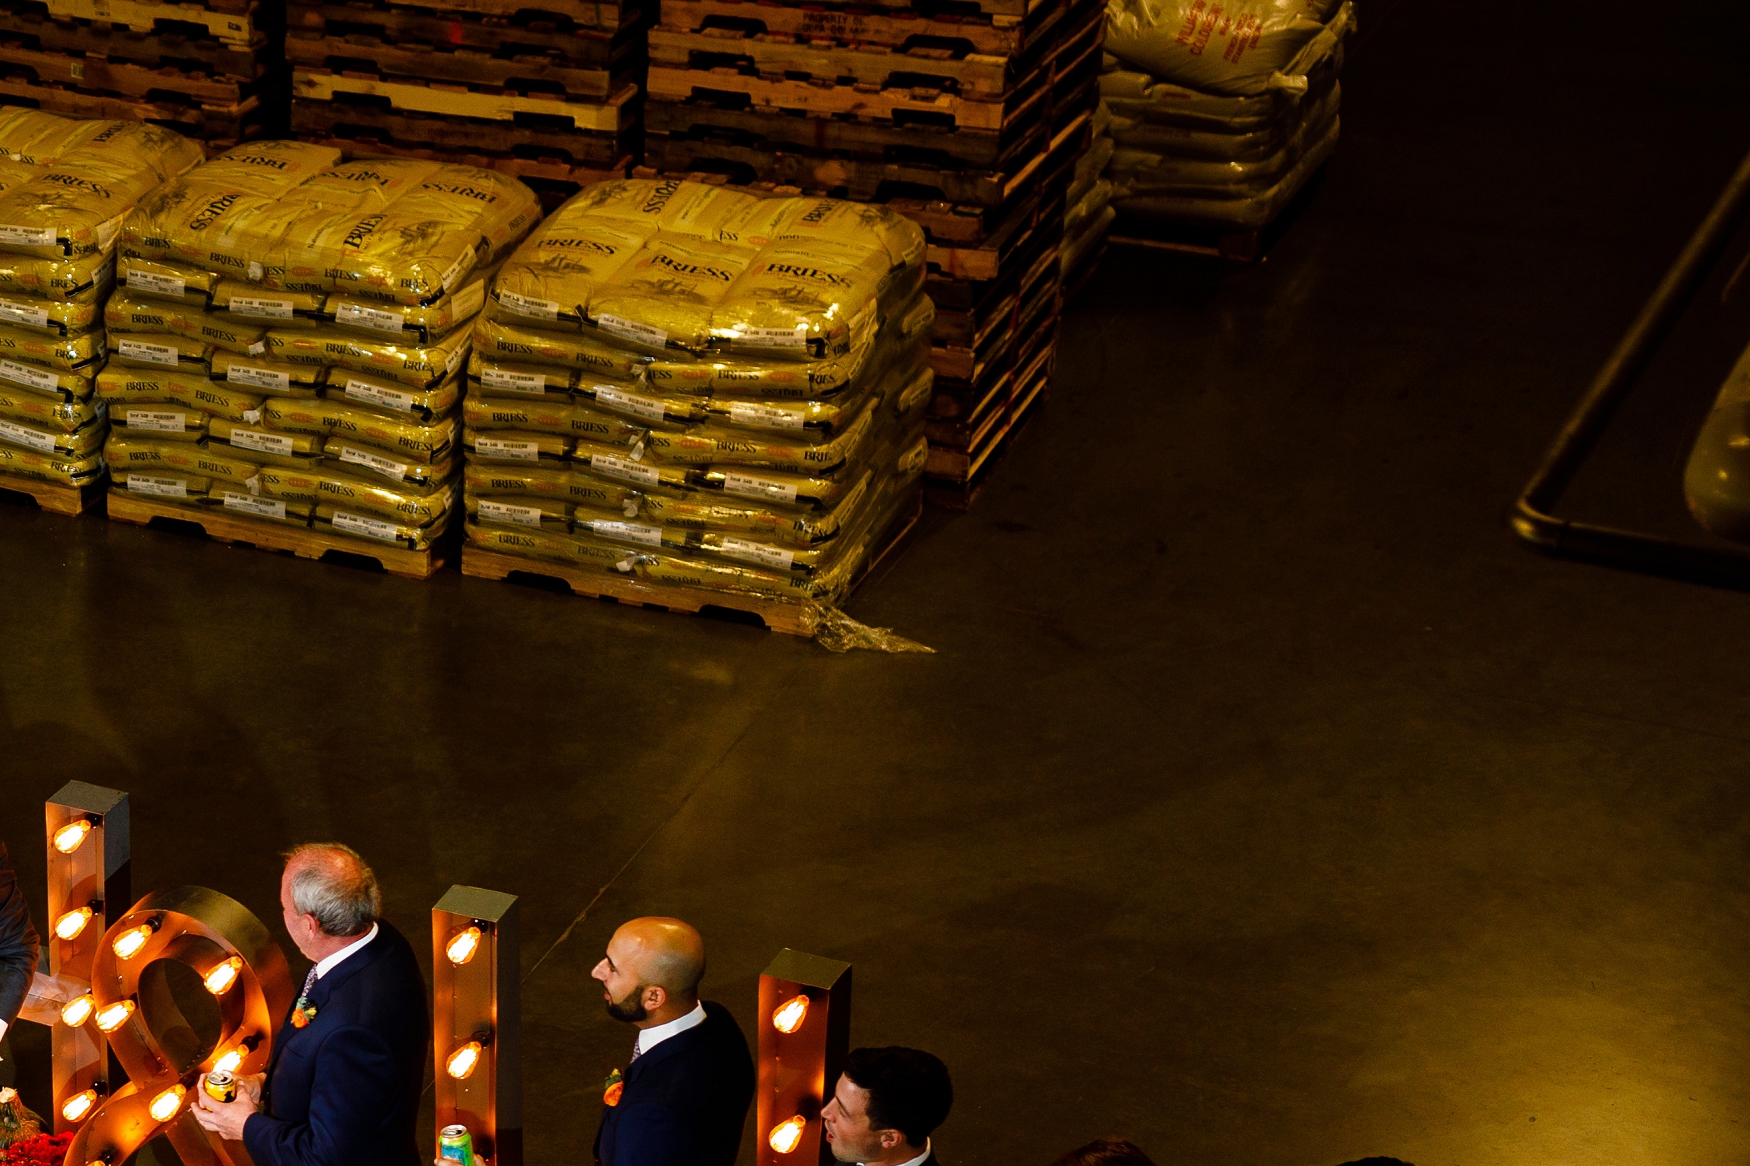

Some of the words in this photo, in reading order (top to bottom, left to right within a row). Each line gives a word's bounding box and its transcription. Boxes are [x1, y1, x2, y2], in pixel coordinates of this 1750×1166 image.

[43, 174, 111, 199] BRIESS
[209, 252, 245, 268] BRIESS
[651, 255, 734, 282] BRIESS
[766, 263, 853, 288] BRIESS
[131, 314, 164, 325] BRIESS
[201, 325, 237, 341] BRIESS
[496, 341, 533, 354] BRIESS
[575, 353, 614, 368] BRIESS
[126, 381, 160, 392] BRIESS
[195, 389, 230, 407] BRIESS
[492, 412, 529, 423] BRIESS
[571, 419, 609, 434] BRIESS
[129, 451, 161, 461] BRIESS
[198, 460, 233, 475] BRIESS
[319, 480, 355, 498] BRIESS
[491, 478, 528, 489] BRIESS
[569, 486, 607, 500] BRIESS
[498, 534, 535, 547] BRIESS
